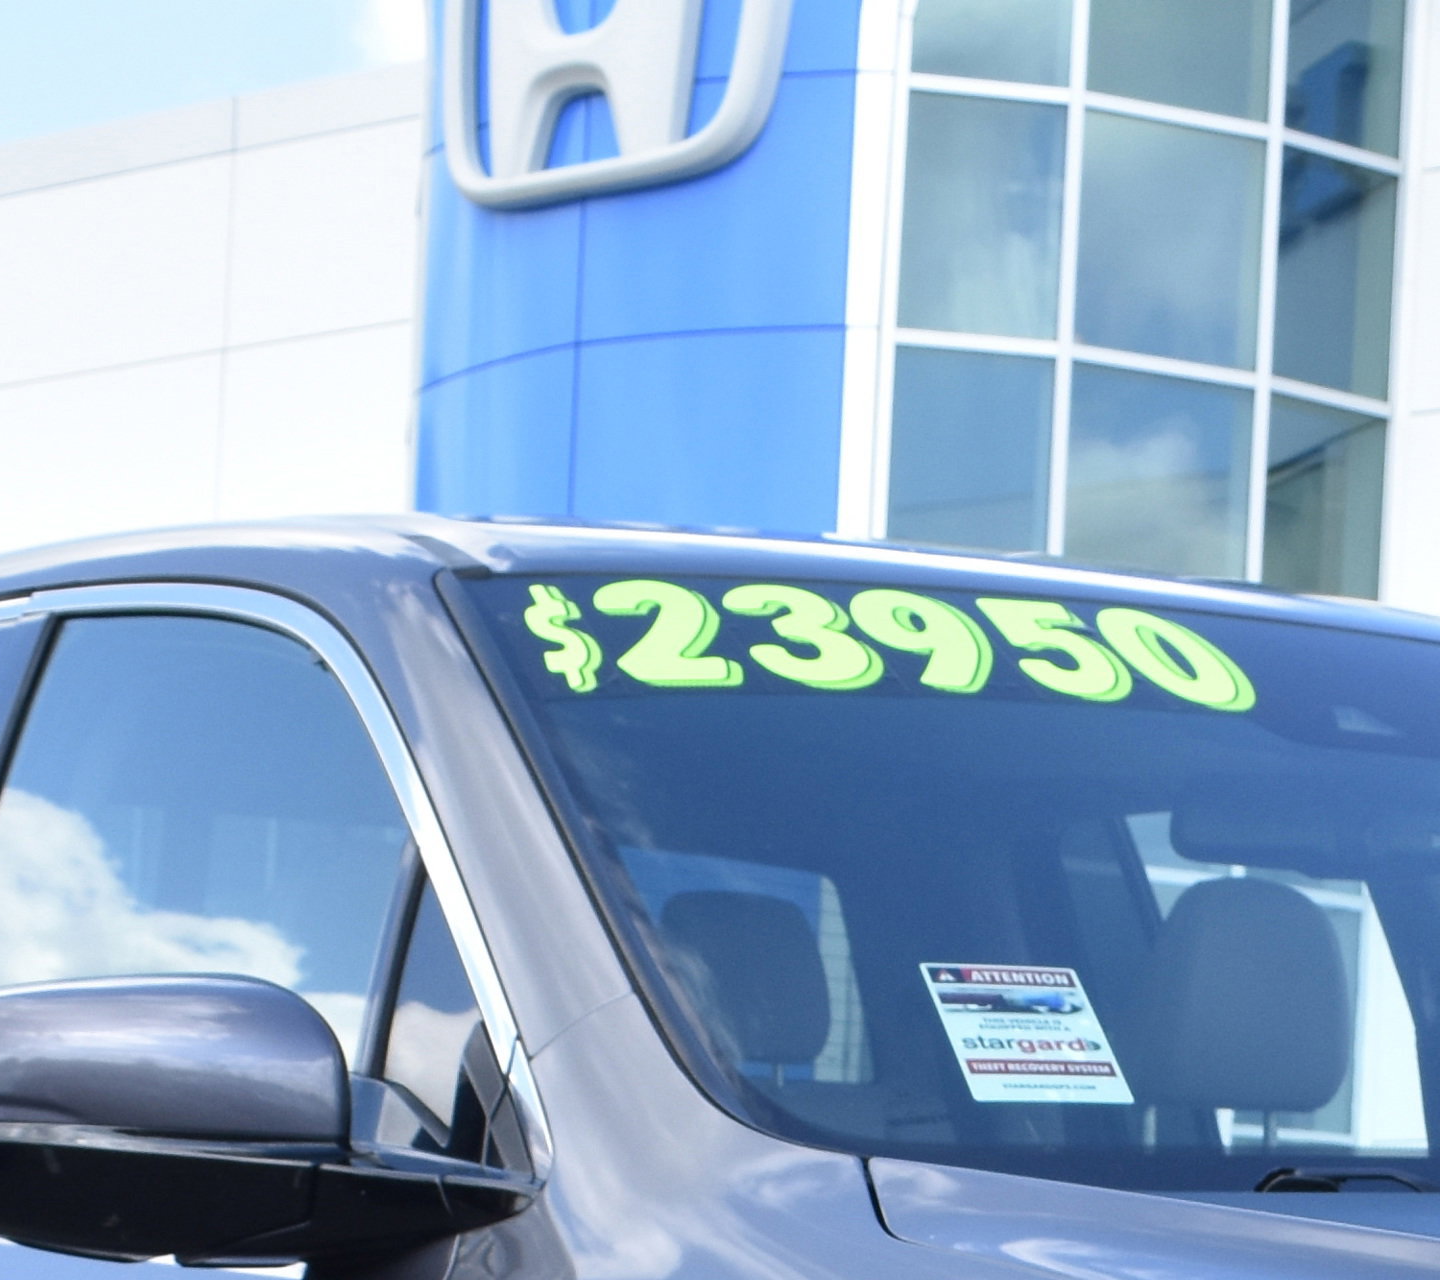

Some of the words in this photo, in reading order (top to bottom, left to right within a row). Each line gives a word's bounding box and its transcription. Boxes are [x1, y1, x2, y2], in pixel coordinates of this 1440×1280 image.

[524, 579, 1256, 713] $23950
[970, 970, 1070, 986] ATTENTION
[971, 1061, 1006, 1073] THEFT
[1007, 1062, 1065, 1074] RECOVERY
[1066, 1063, 1112, 1075] SYSTEM
